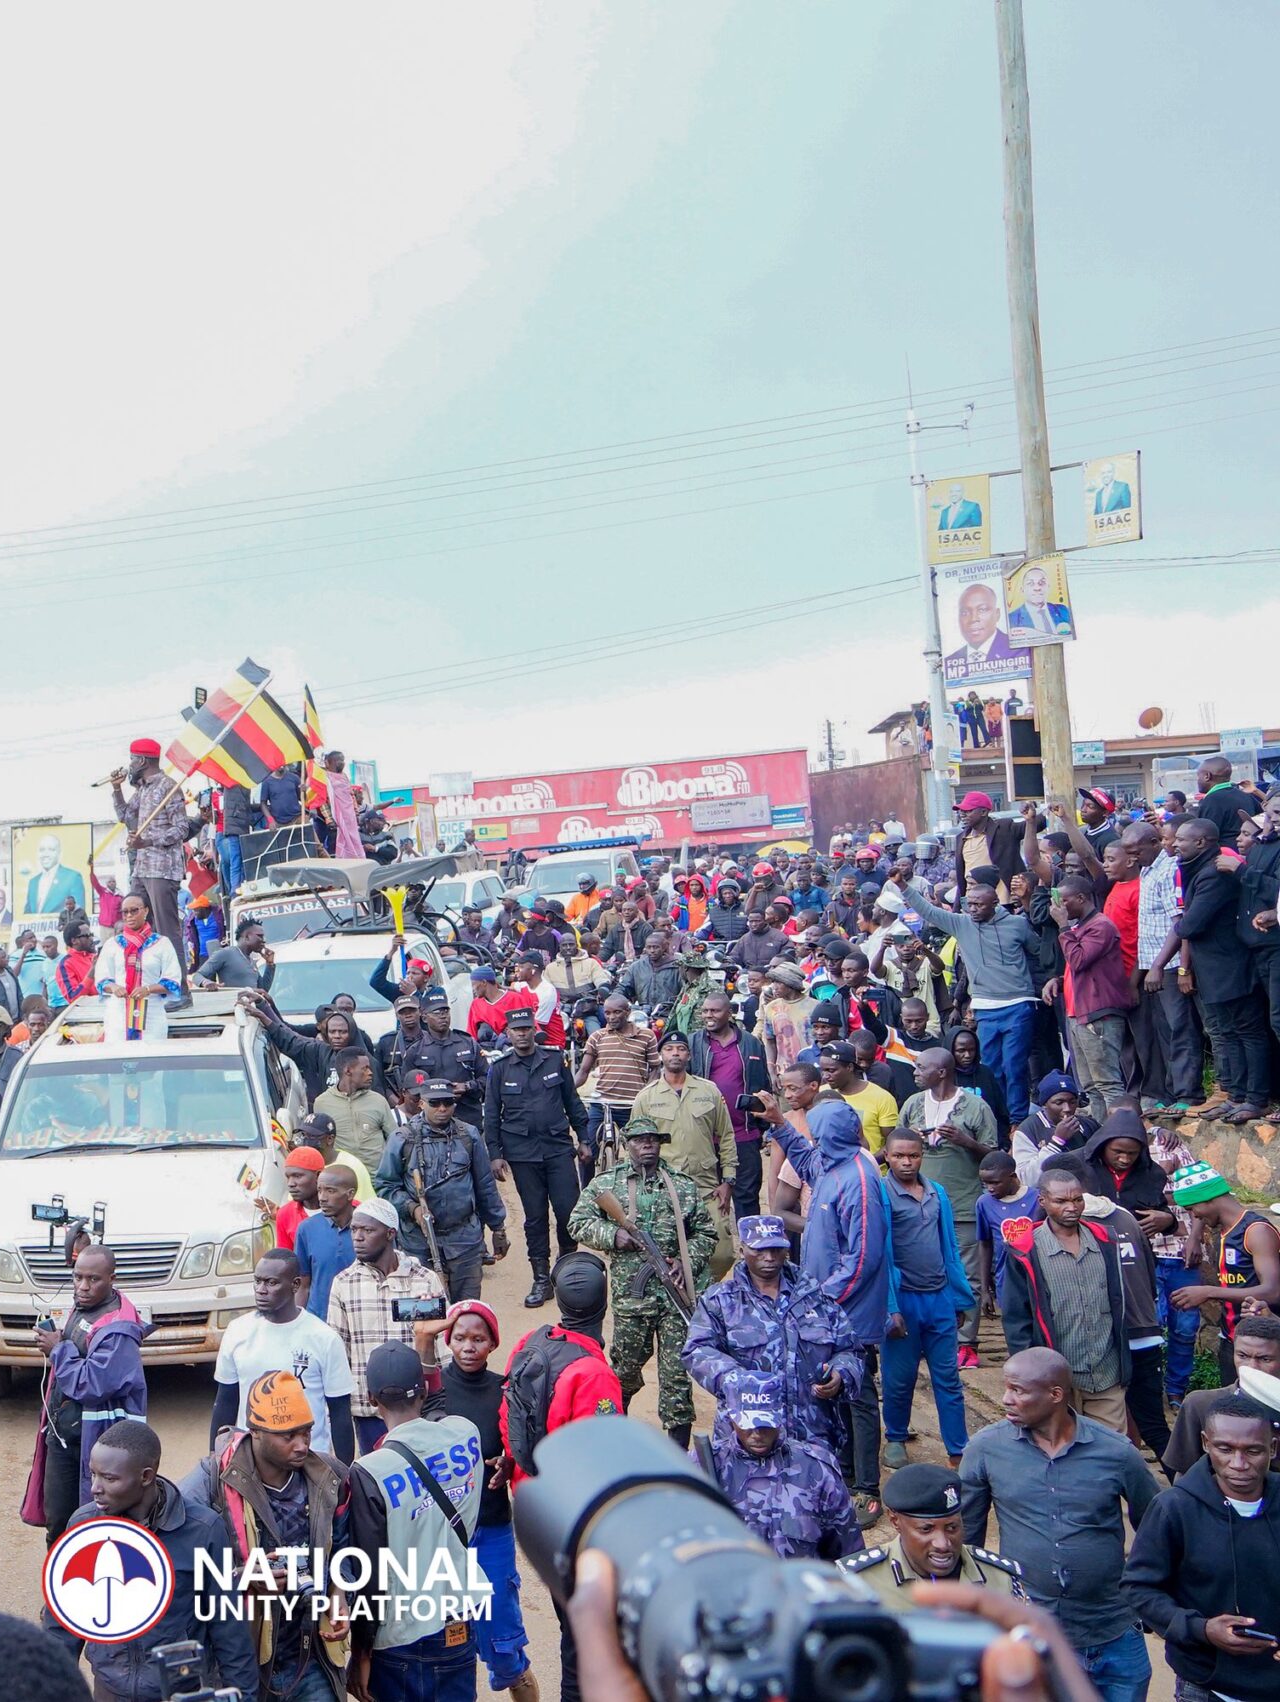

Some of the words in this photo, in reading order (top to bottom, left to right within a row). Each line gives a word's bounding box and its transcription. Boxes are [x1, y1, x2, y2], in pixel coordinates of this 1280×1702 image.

[1094, 513, 1132, 529] ISAAC
[938, 531, 982, 544] ISAAC
[946, 667, 966, 680] MP
[968, 656, 1030, 673] RUKUNGIRI
[947, 658, 965, 667] FOR
[240, 906, 280, 920] YESU
[512, 1011, 528, 1019] POLICE
[755, 1225, 779, 1234] POLICE
[292, 1364, 308, 1389] K
[741, 1393, 772, 1404] POLICE
[383, 1436, 480, 1509] PRESS
